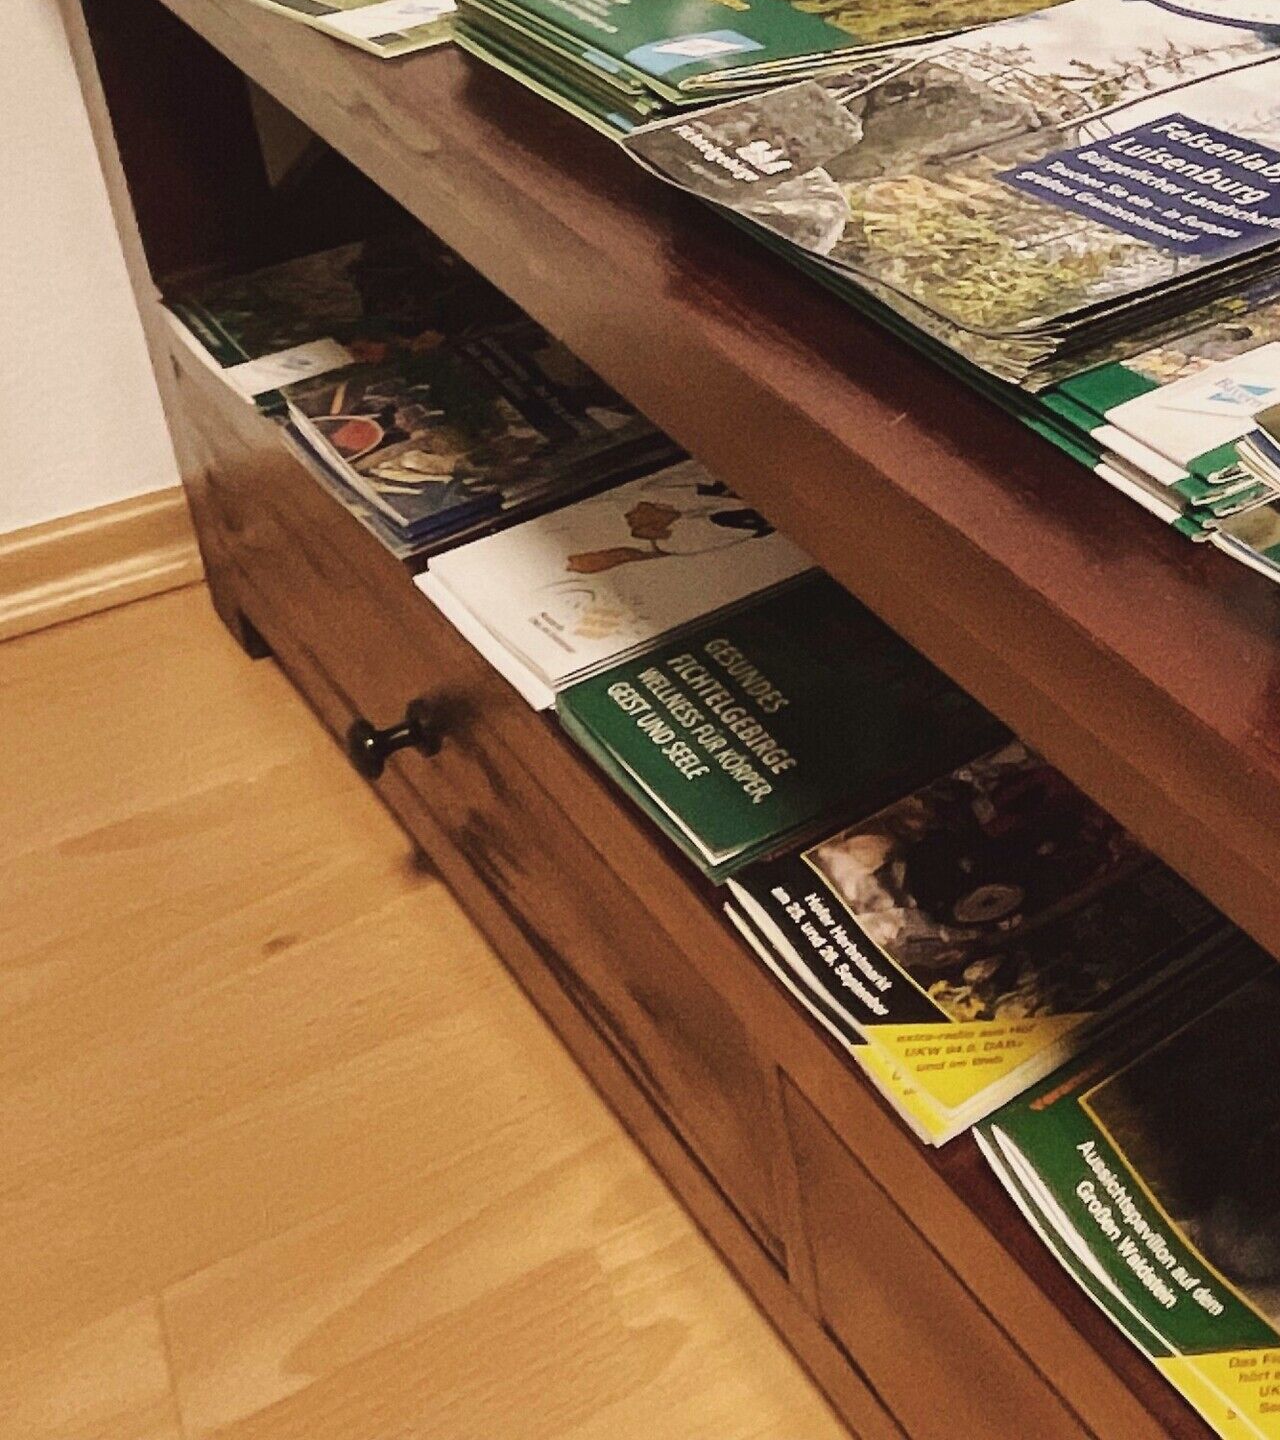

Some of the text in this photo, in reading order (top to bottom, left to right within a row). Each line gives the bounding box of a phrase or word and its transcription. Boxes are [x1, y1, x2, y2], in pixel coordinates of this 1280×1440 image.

[1108, 136, 1272, 205] Luisenburg
[607, 681, 711, 781] GEIST UND SEELE
[637, 666, 774, 805] WELLNESS FÜR KÖRPER
[666, 653, 798, 776] FICHTELGEBIRGE
[704, 637, 791, 714] GESUNDES
[1075, 1140, 1177, 1271] Aussichtspavillon
[1170, 1266, 1202, 1291] auf
[1075, 1179, 1178, 1310] Großen Waldstein
